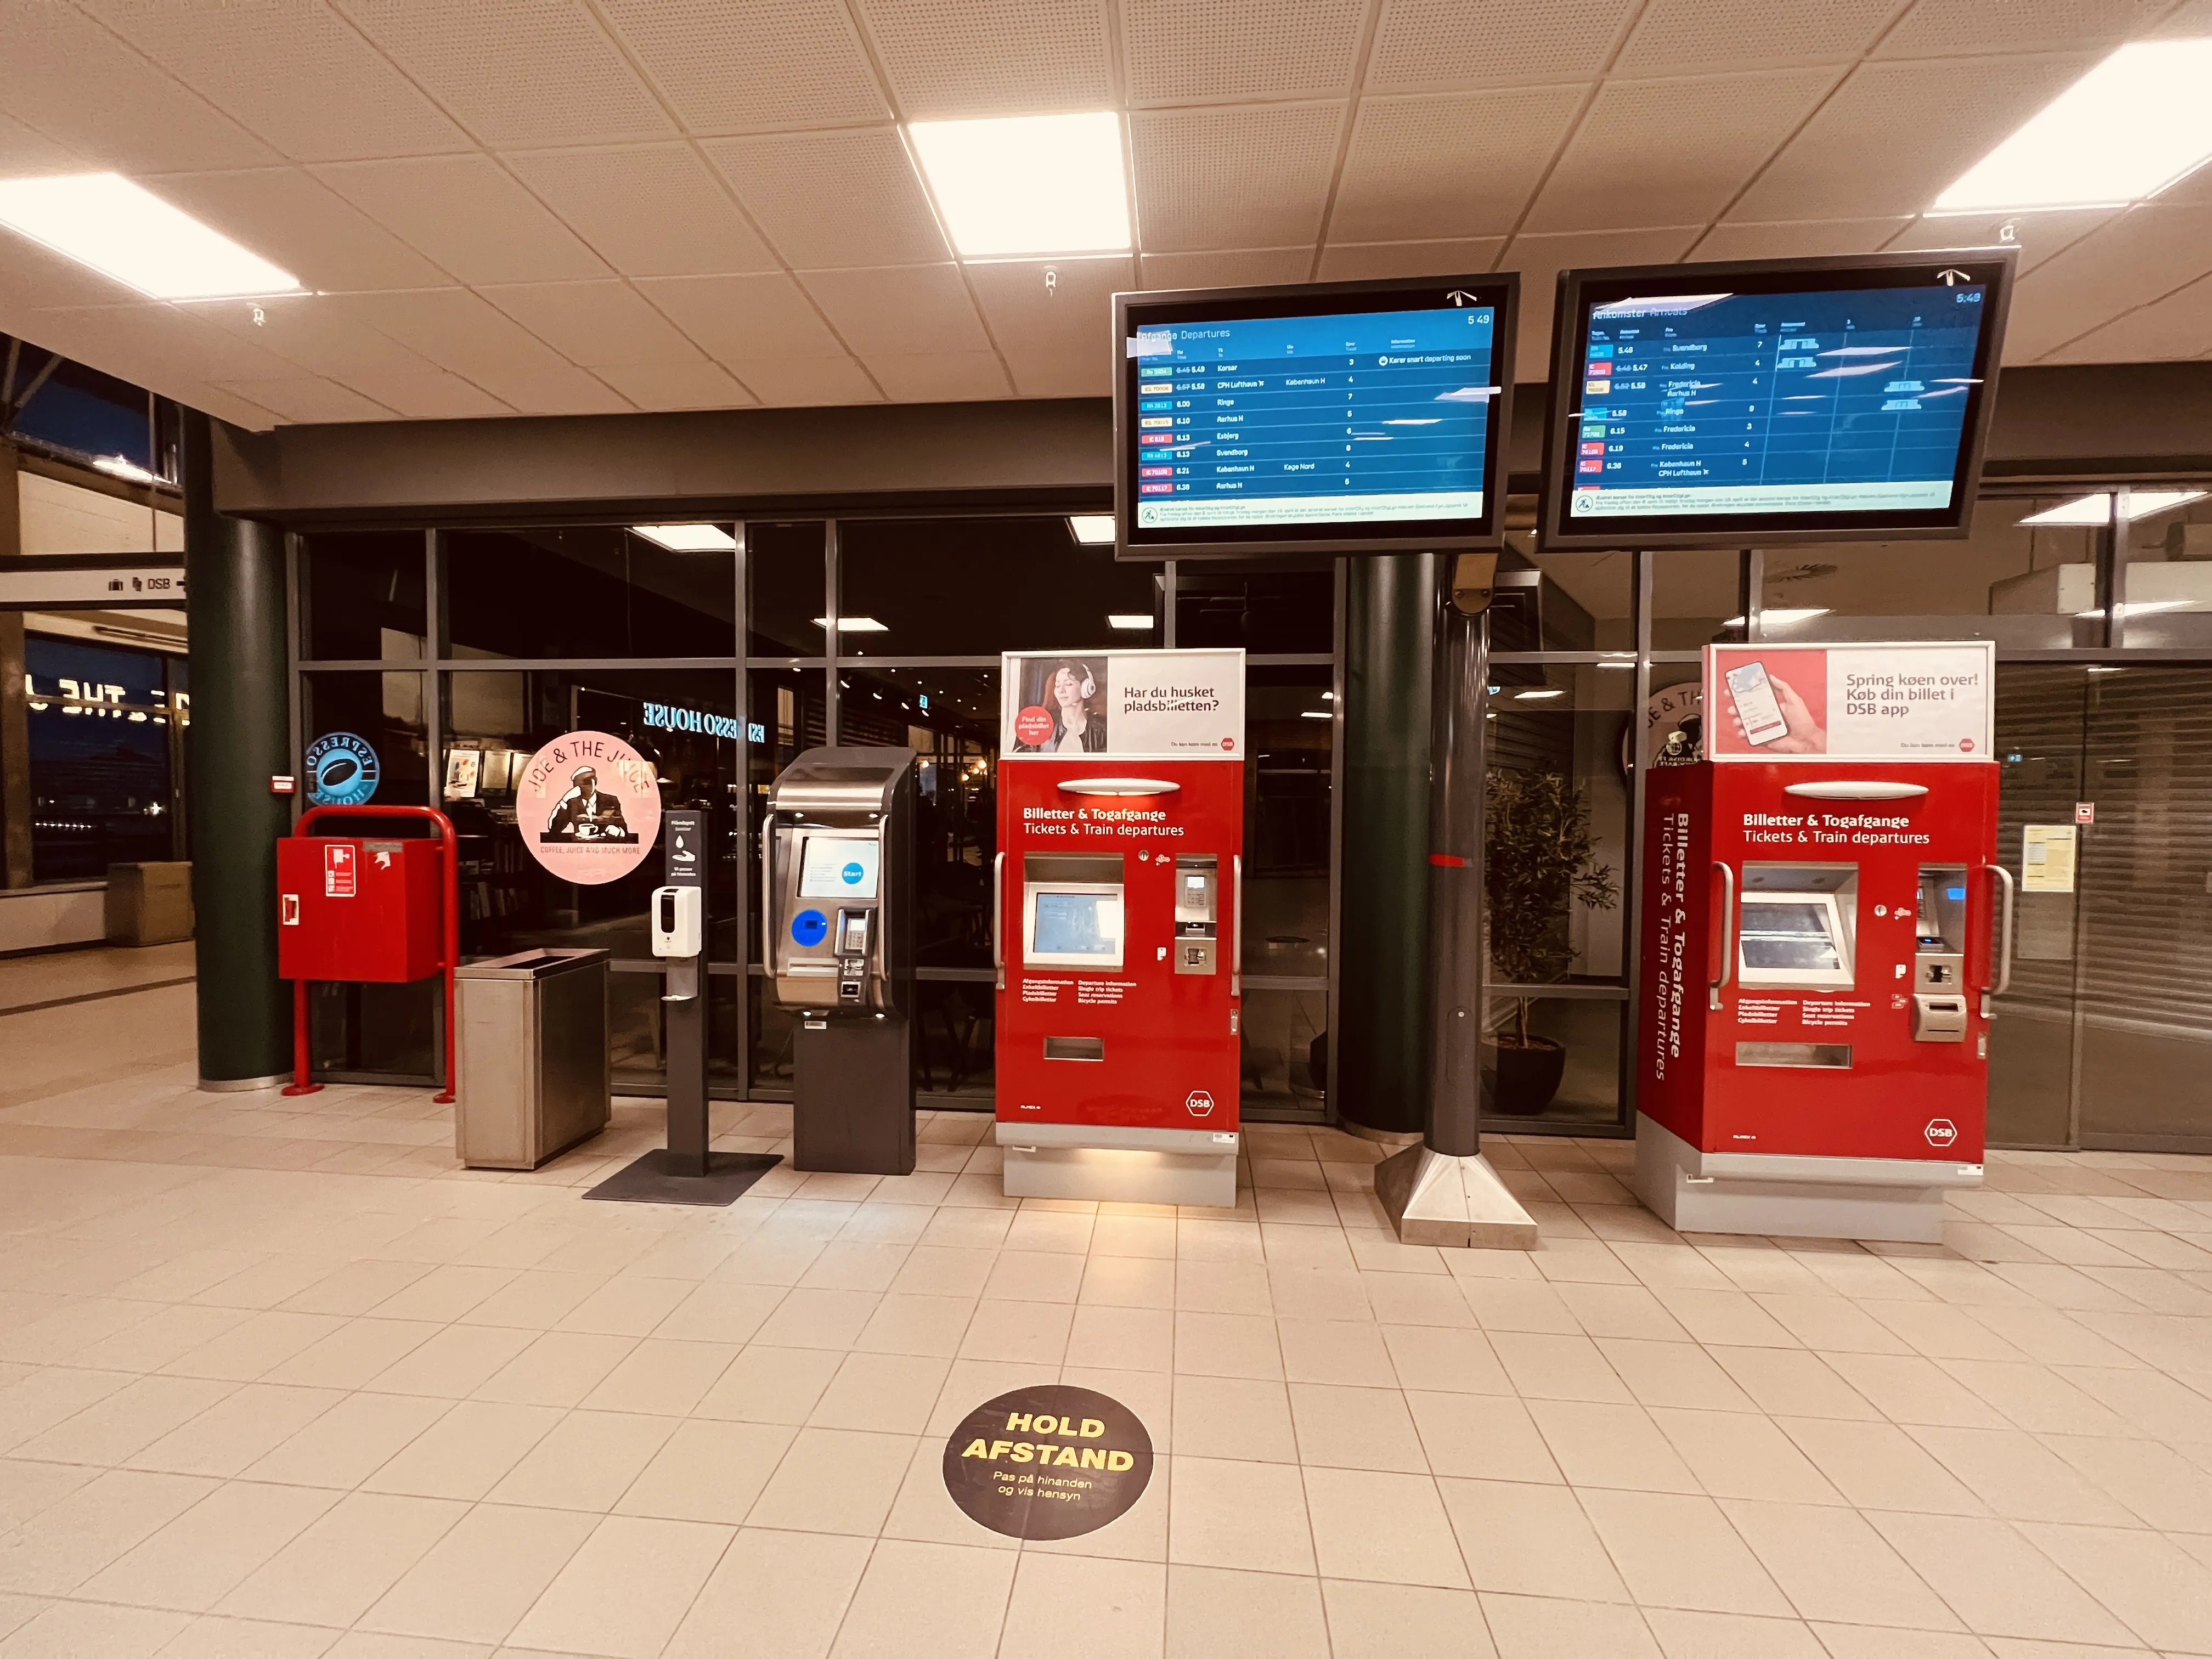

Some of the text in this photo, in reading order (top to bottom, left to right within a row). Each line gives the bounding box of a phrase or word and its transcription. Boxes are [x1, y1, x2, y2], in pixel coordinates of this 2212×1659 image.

[1956, 292, 1981, 304] 5:49
[1593, 309, 1646, 319] Ankomster
[1141, 330, 1230, 342] Afgange Departures
[1425, 354, 1455, 363] departing
[1671, 362, 1695, 371] Kolding
[1217, 432, 1239, 441] Esbjerg
[1661, 442, 1694, 450] Fredericia
[1217, 449, 1248, 457] Svendborg
[1672, 469, 1702, 477] Lufthavn
[147, 578, 171, 590] DSB
[1847, 673, 1978, 688] Spring køen over!
[1124, 686, 1215, 698] Har du husket
[1847, 689, 1954, 701] Køb din billet i
[1124, 699, 1220, 714] pladsbilletten?
[1661, 691, 1701, 712] & TH
[1847, 703, 1910, 718] DSB app
[528, 759, 554, 793] JOE
[554, 748, 568, 764] &
[569, 741, 605, 758] THE
[1023, 808, 1166, 822] Billetter & Togafgange
[1743, 814, 1910, 828] Billetter & Togafgange
[1024, 823, 1184, 838] Tickets & Train departures
[1743, 830, 1930, 845] Tickets & Train departures
[566, 846, 584, 854] JUICE
[601, 847, 620, 855] MUCH
[1669, 813, 1689, 1059] Billetter & Togafgange
[1656, 812, 1674, 1081] Tickets & Train departures
[1190, 1099, 1210, 1108] DSB
[1929, 1128, 1953, 1137] DSB
[1006, 1412, 1105, 1438] HOLD
[961, 1438, 1135, 1471] AFSTAND
[993, 1471, 1093, 1489] Pas på hinanden
[998, 1486, 1081, 1502] og vis hensyn
